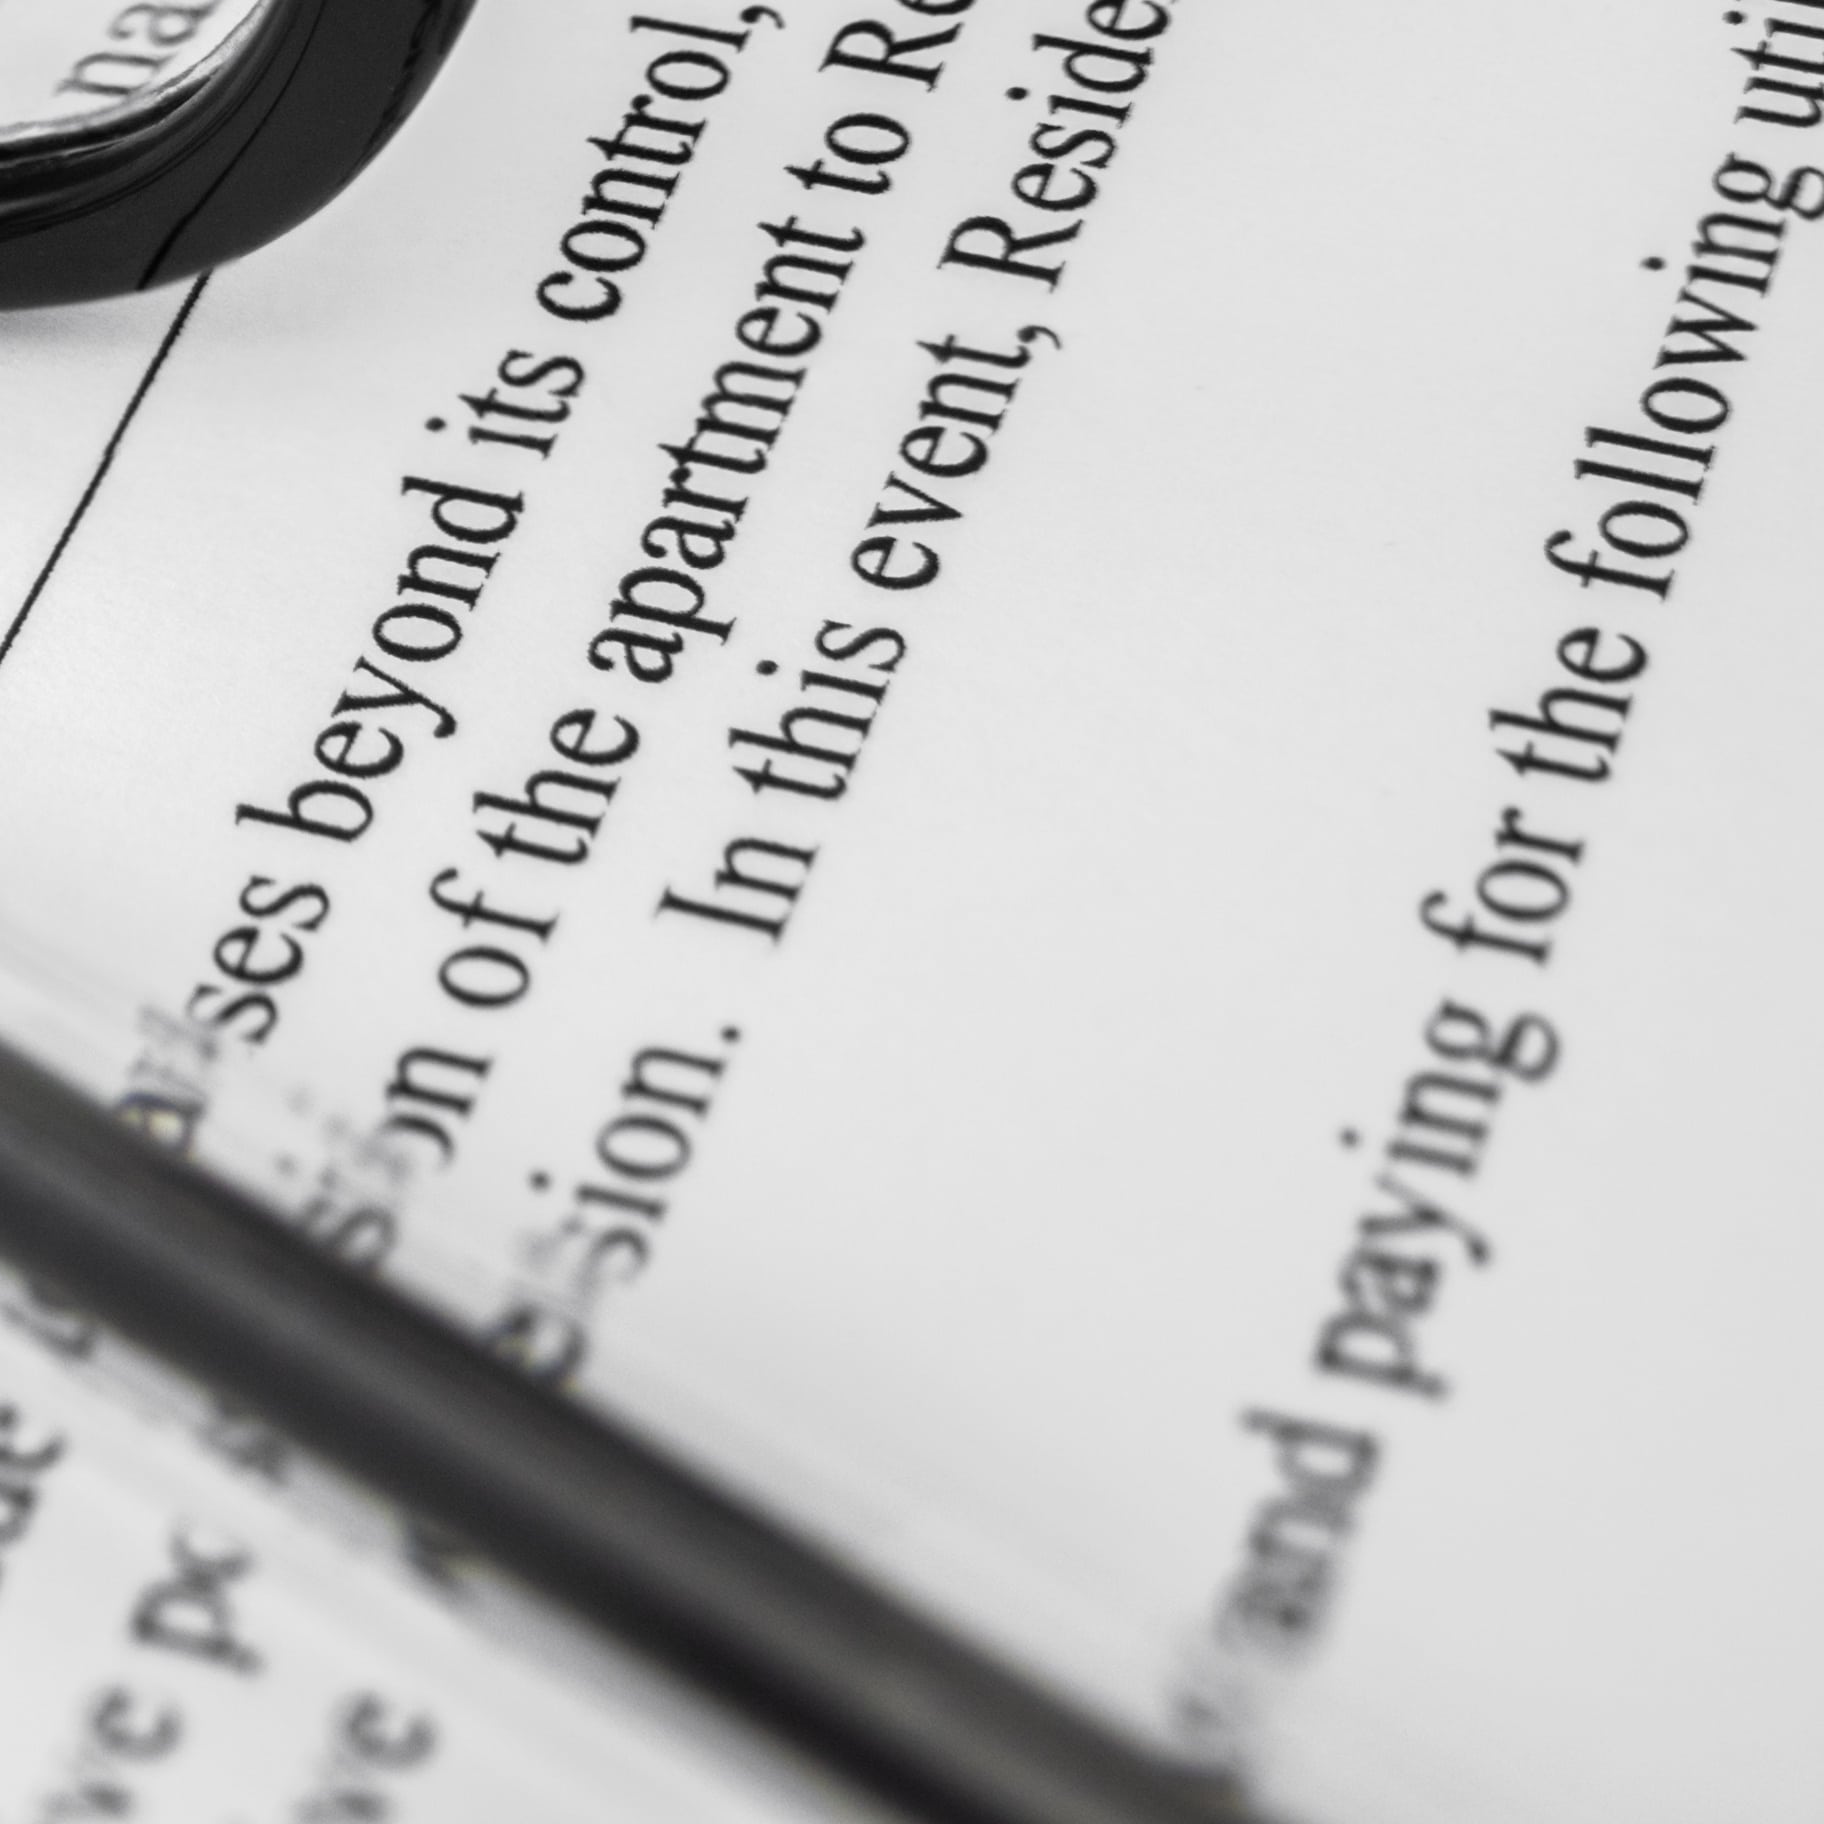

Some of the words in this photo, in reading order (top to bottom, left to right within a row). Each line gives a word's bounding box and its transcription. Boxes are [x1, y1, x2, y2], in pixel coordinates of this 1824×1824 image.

[782, 109, 914, 199] to
[233, 475, 527, 845] beyond
[424, 347, 585, 457] its
[535, 2, 786, 324] control,
[585, 213, 867, 686] apartment
[847, 321, 1064, 594] event,
[1545, 149, 1824, 601] following
[472, 706, 642, 868] the
[727, 616, 910, 804] this
[1489, 624, 1649, 784] the
[430, 866, 559, 1011] of
[654, 831, 822, 946] In
[1417, 806, 1587, 966] for
[1312, 996, 1560, 1403] paying
